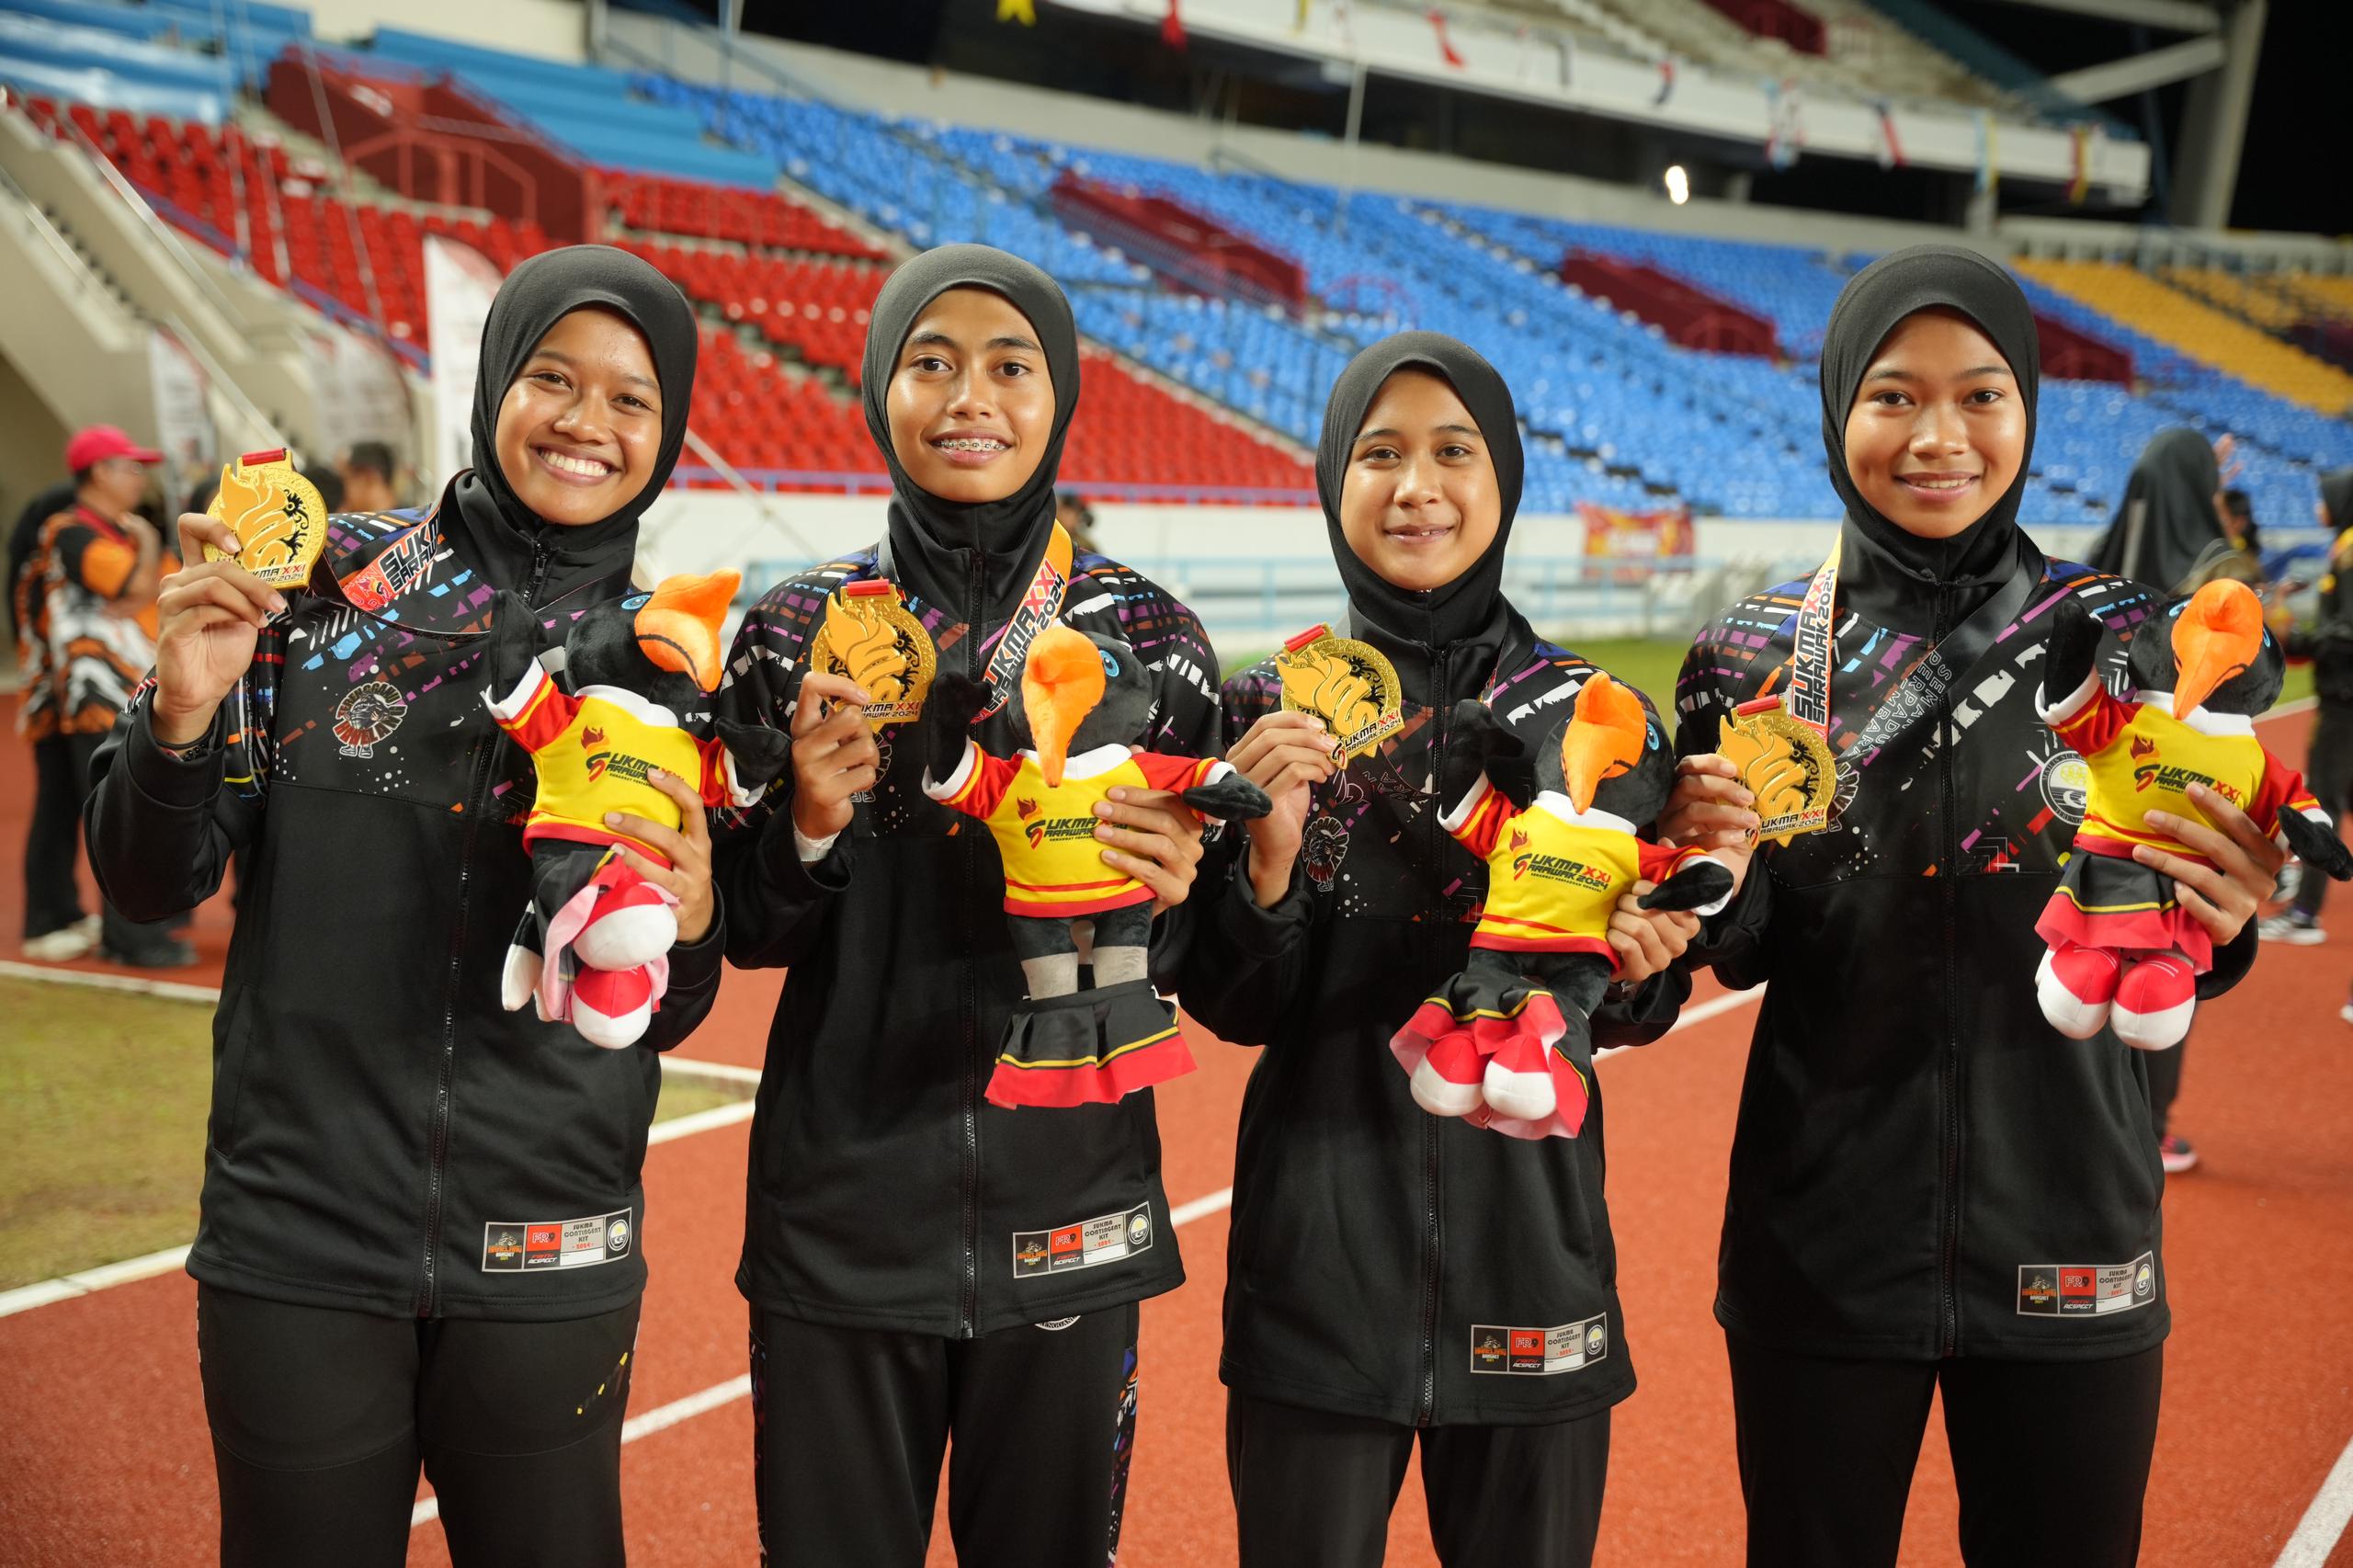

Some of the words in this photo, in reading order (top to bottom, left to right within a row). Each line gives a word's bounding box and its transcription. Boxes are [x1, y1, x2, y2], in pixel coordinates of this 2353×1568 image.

[1818, 568, 1836, 620] 2024
[984, 605, 1036, 695] UKMA
[1793, 610, 1818, 722] SUKMA
[1813, 619, 1828, 725] SARAWAK
[1576, 876, 1608, 890] 2024
